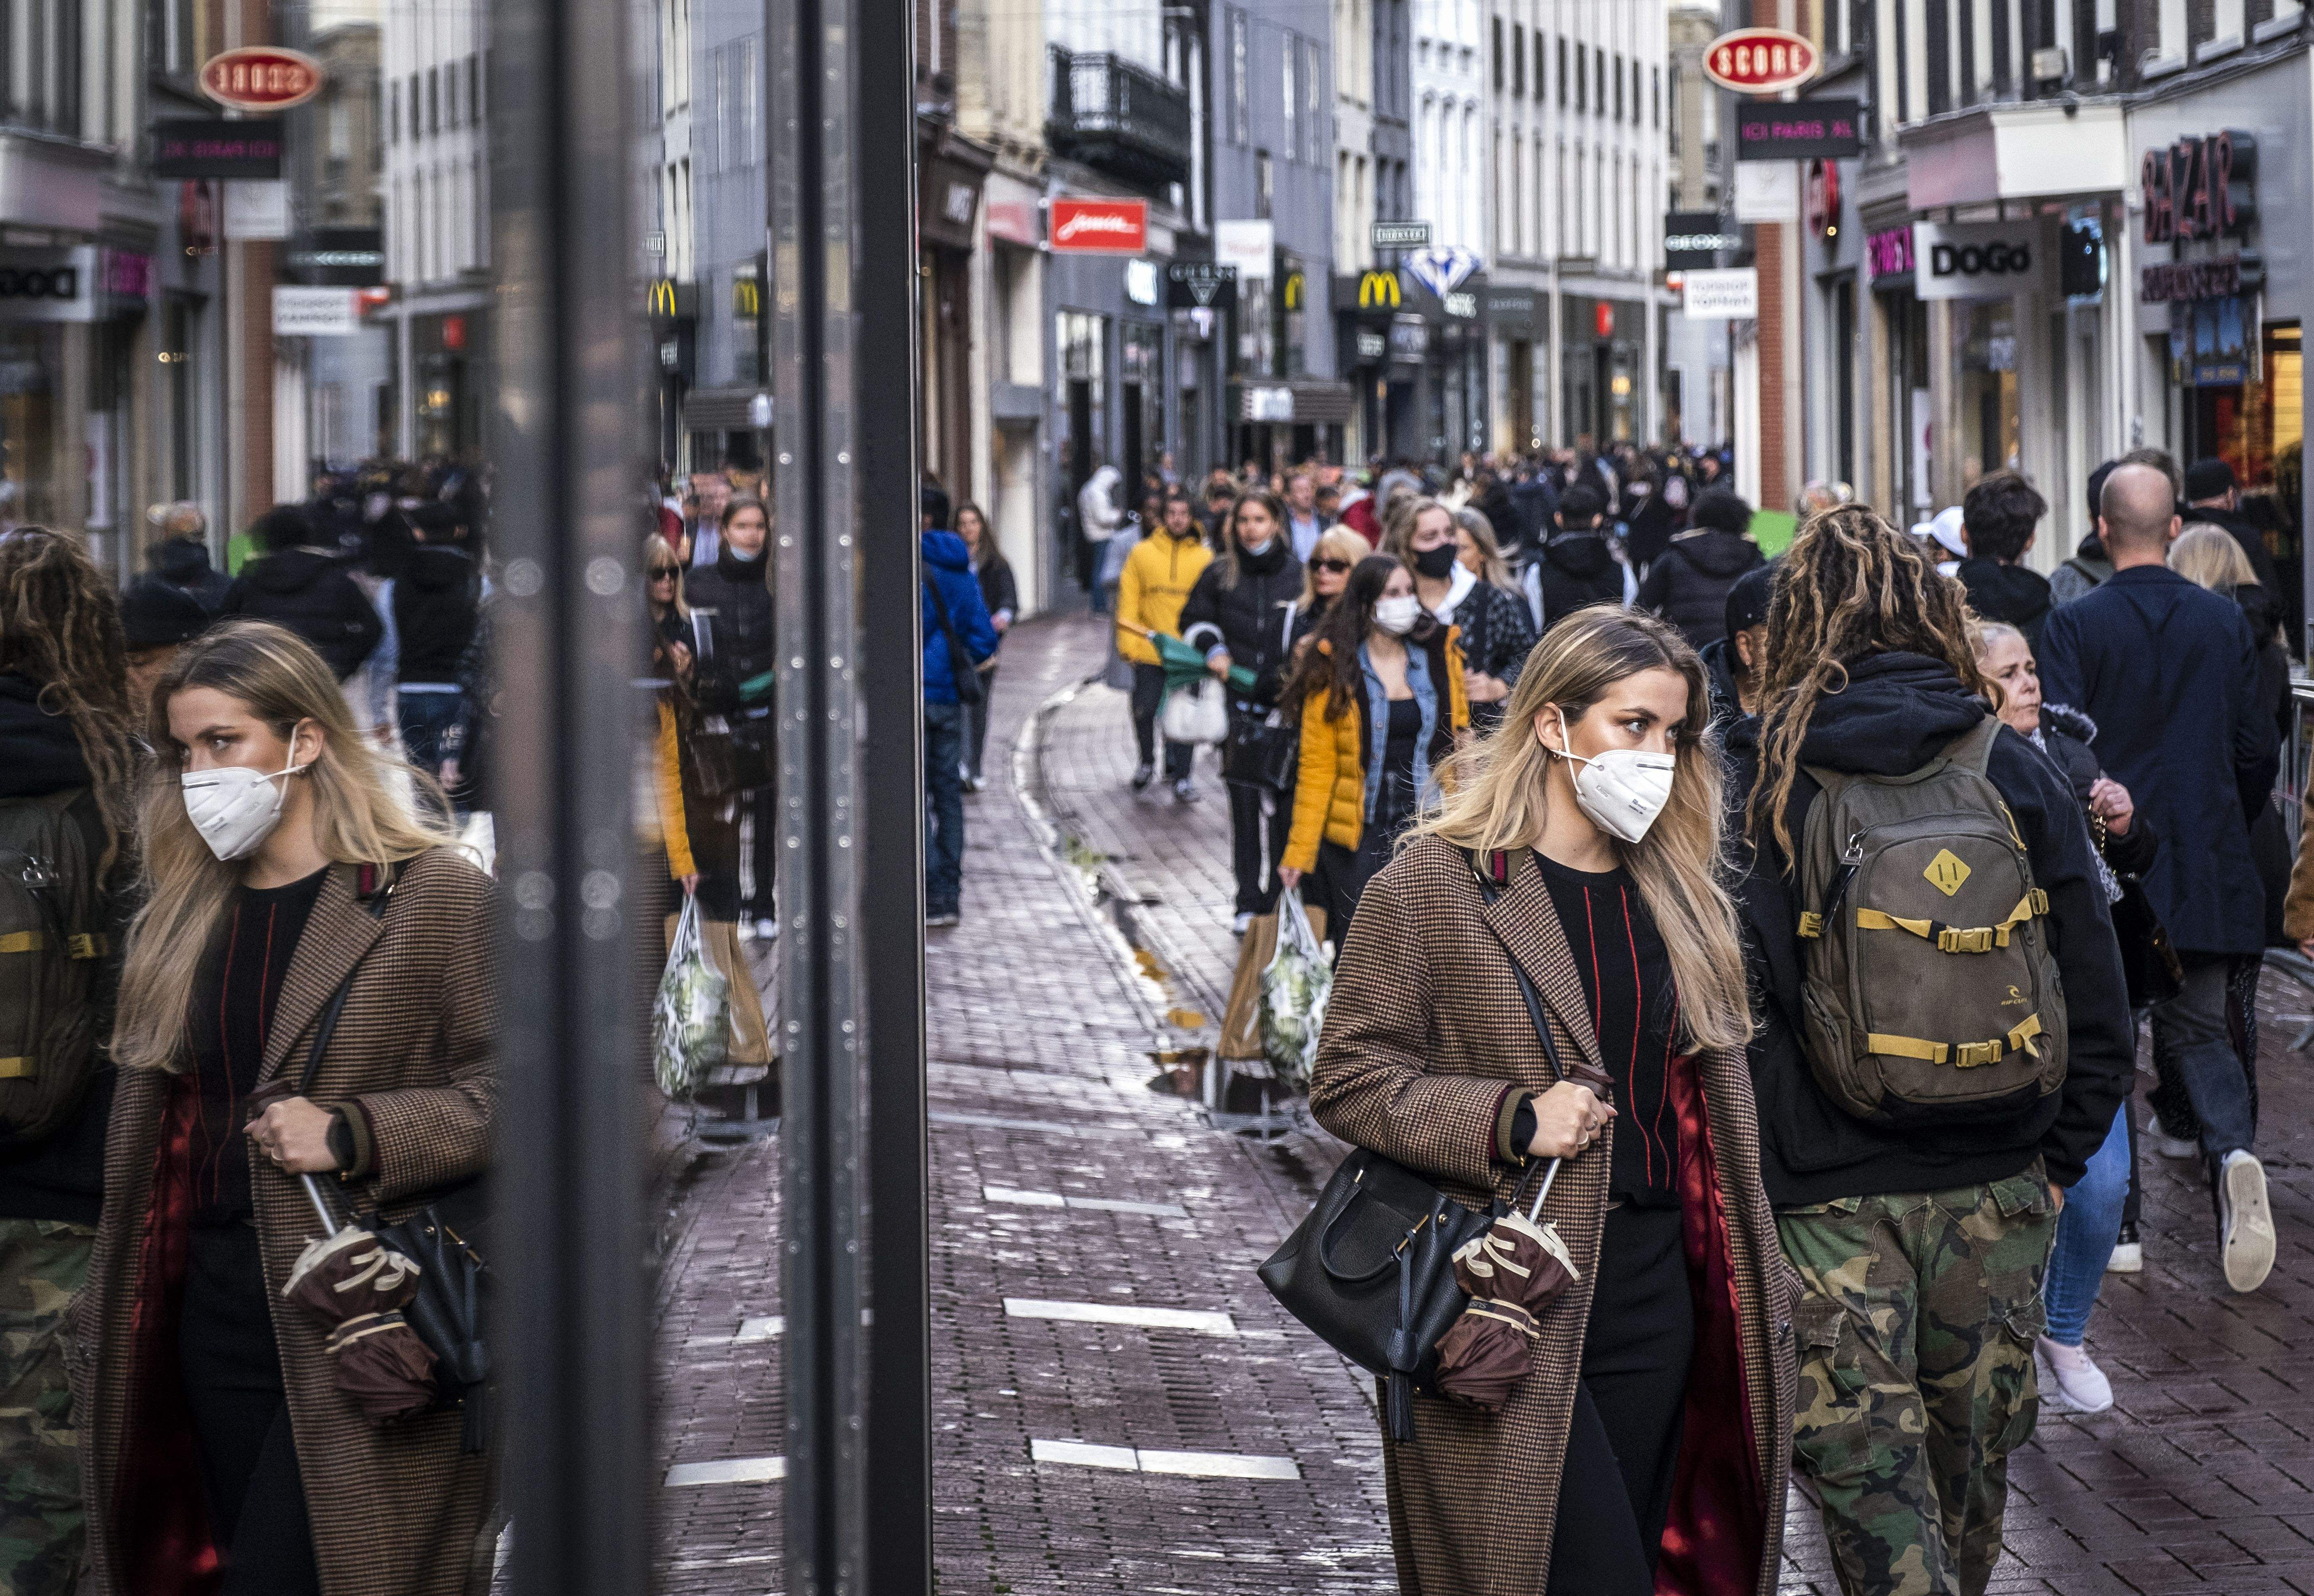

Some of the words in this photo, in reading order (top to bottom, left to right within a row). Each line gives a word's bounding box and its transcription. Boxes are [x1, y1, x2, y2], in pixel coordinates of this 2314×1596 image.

[1718, 44, 1803, 77] SCORE
[1742, 122, 1768, 141] ICI
[1771, 120, 1825, 139] PARIS
[2142, 131, 2237, 242] BAZAR
